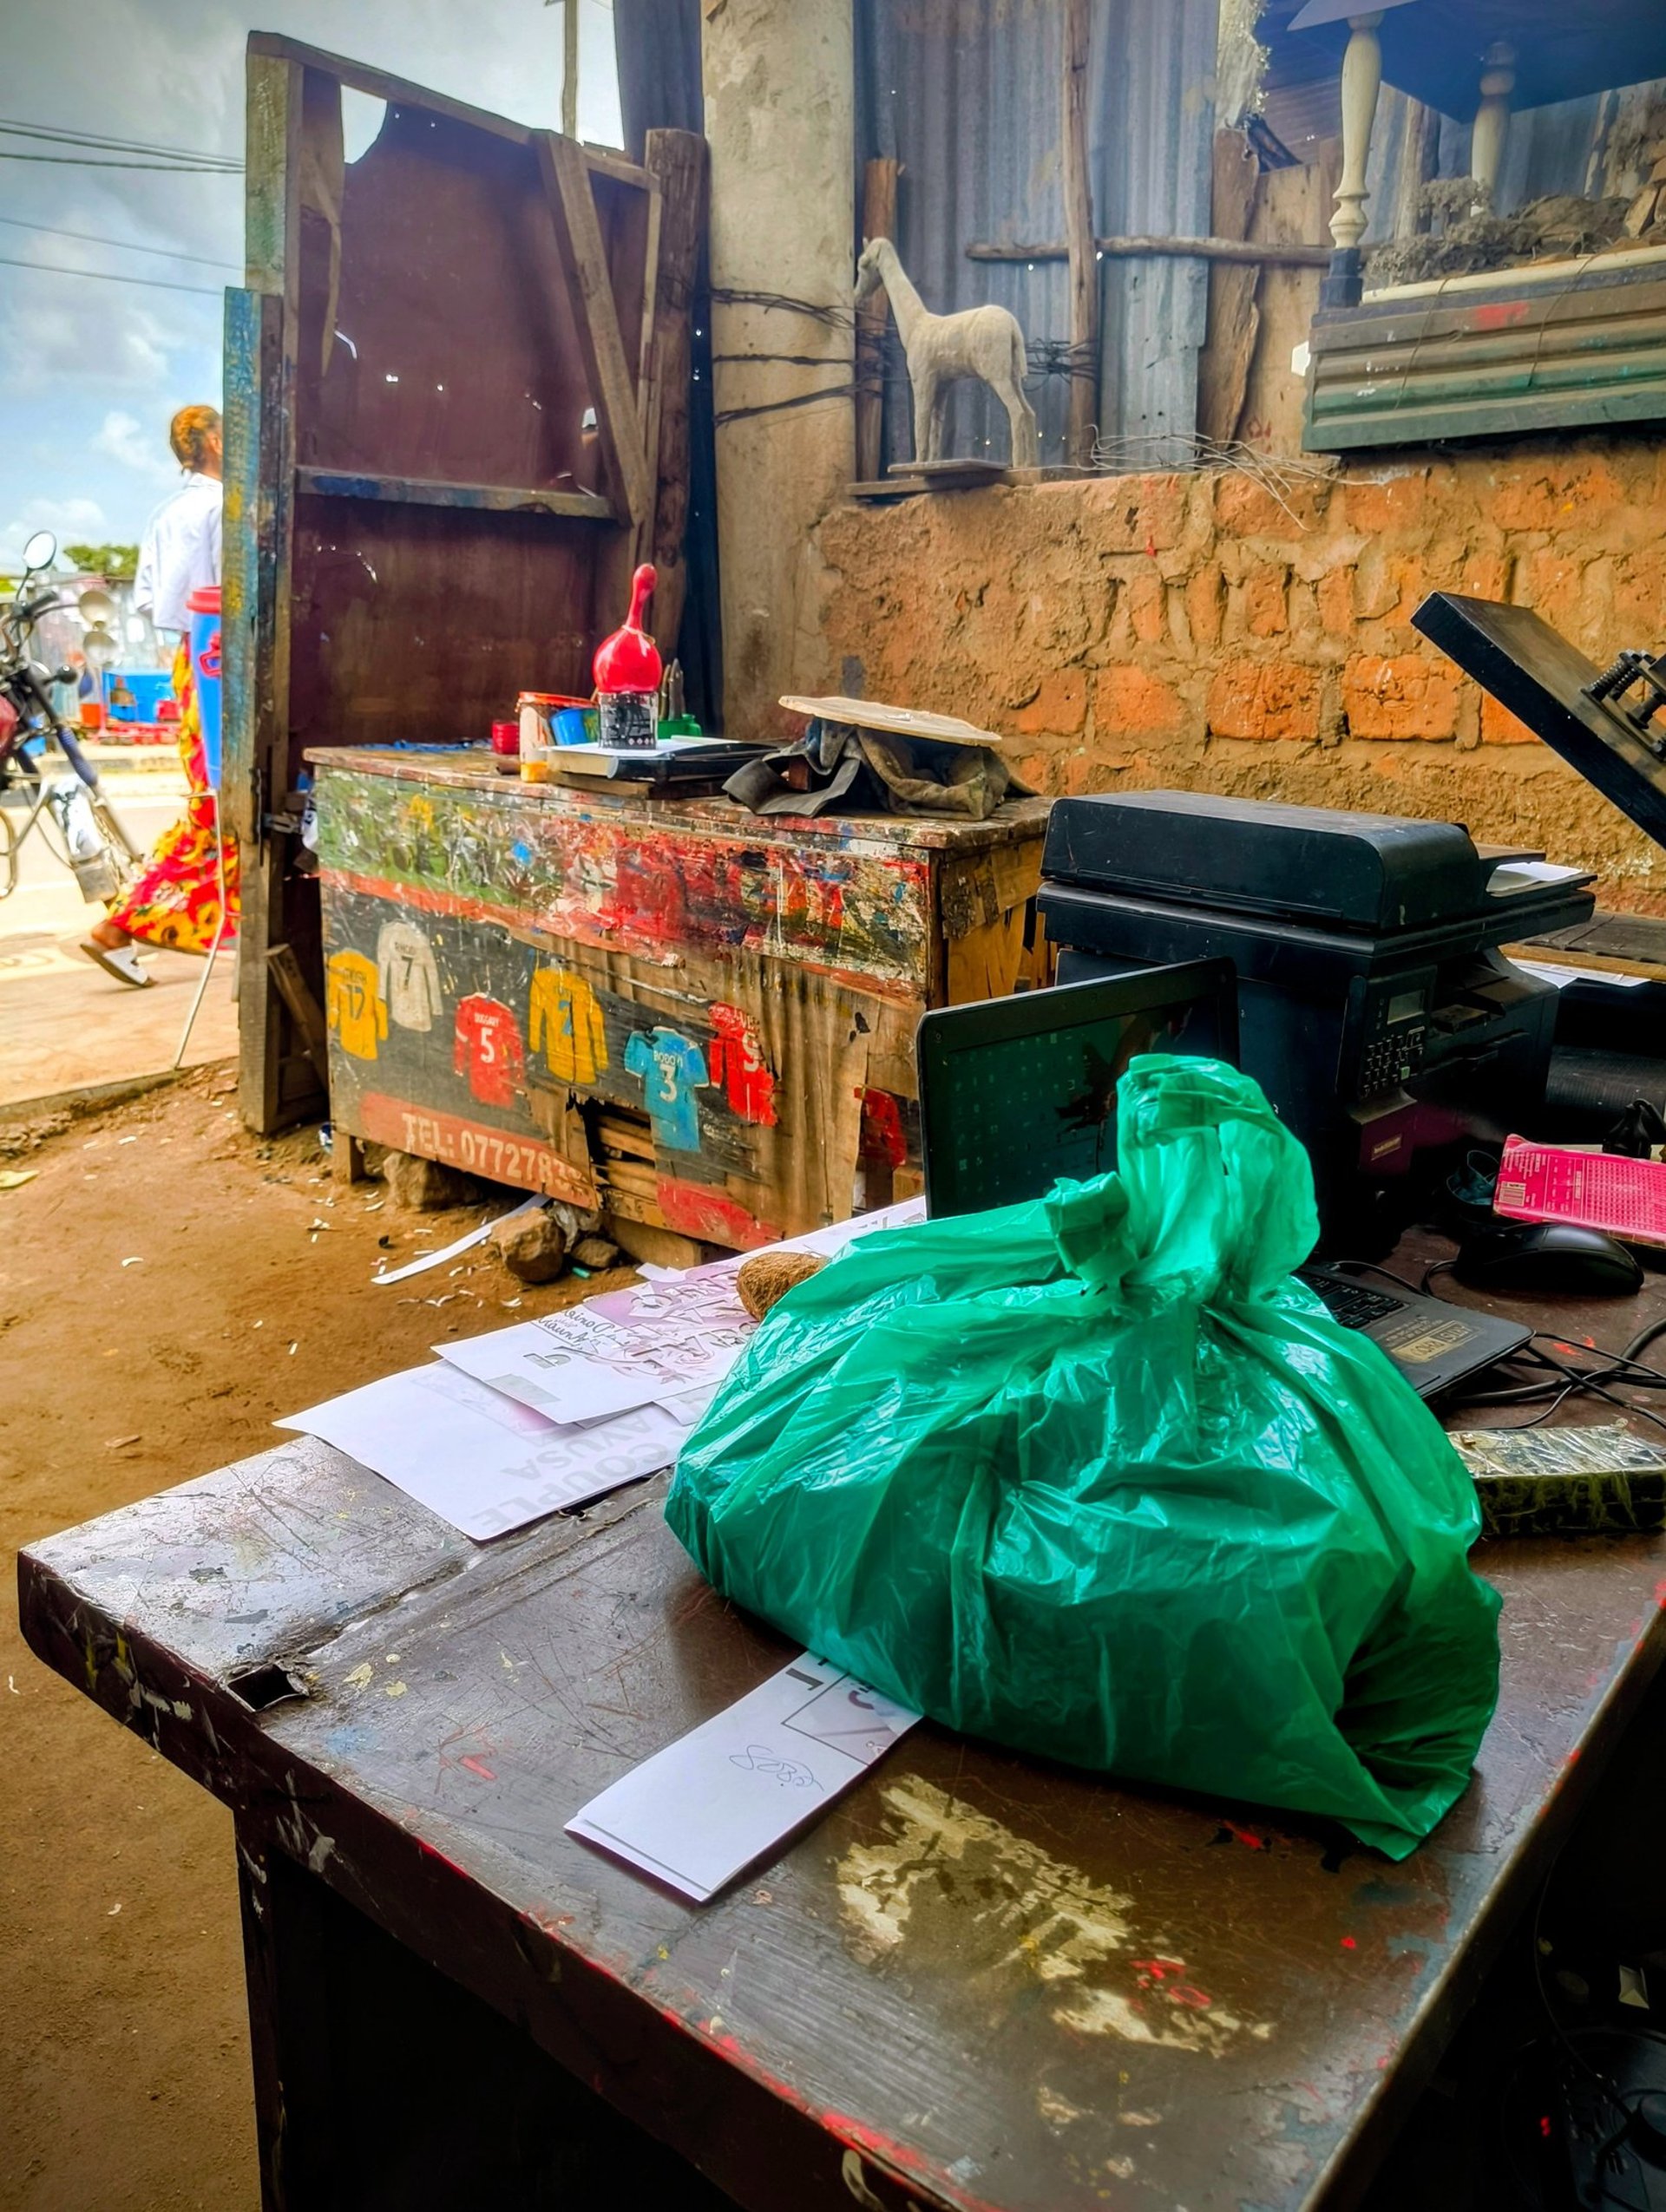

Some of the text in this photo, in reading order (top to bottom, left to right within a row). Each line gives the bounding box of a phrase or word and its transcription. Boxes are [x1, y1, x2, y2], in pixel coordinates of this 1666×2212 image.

[400, 954, 415, 991] 7
[479, 1026, 495, 1063] 5
[659, 1063, 678, 1103] 3
[402, 1112, 456, 1158] TEL:
[470, 1442, 669, 1533] COUPLE
